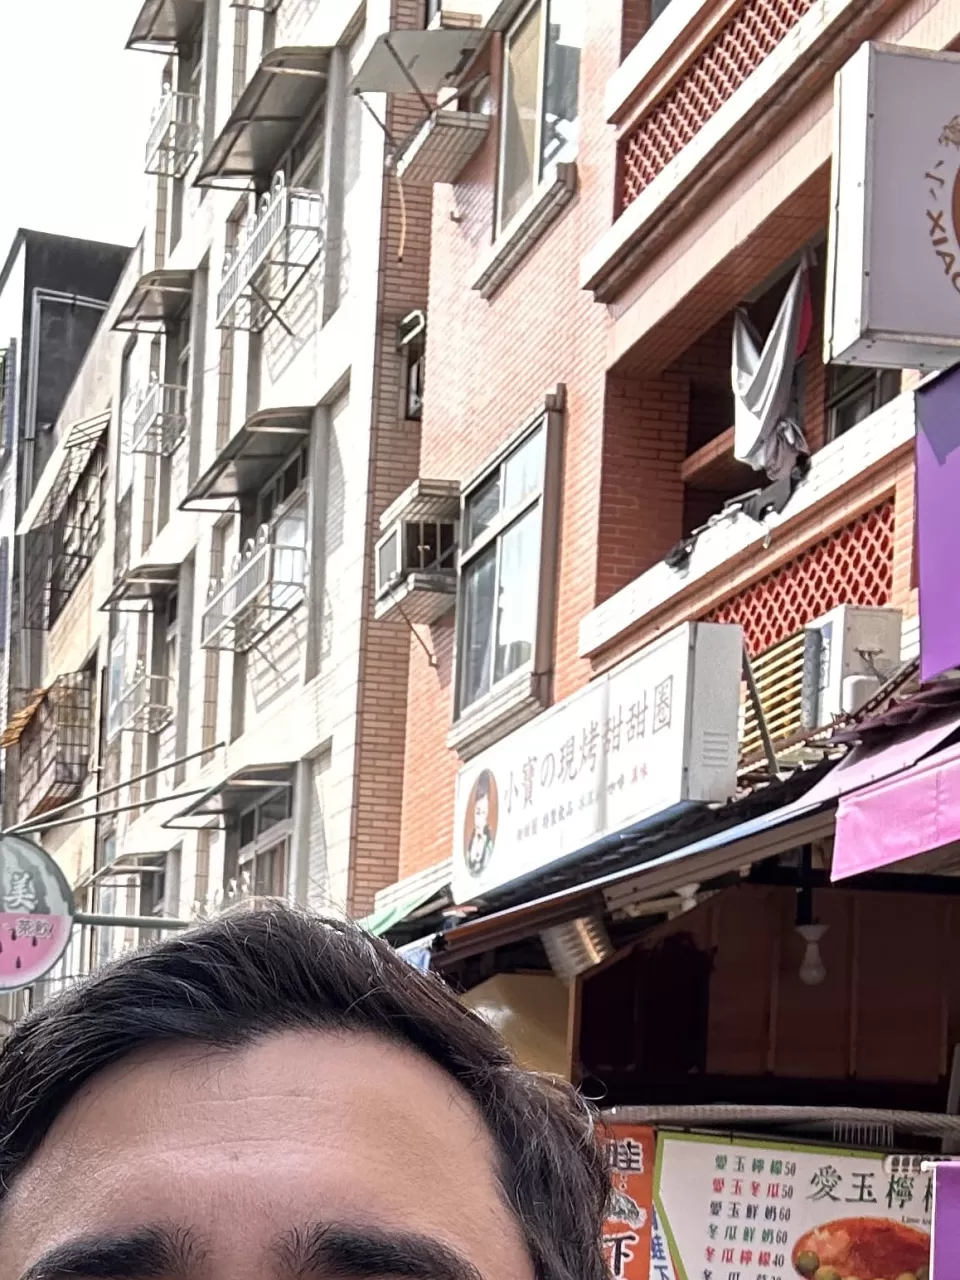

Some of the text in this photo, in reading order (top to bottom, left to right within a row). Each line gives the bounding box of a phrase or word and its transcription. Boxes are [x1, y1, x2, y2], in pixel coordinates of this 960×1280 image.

[504, 674, 674, 815] 小寶の現烤甜甜圈
[783, 1160, 797, 1177] 50
[780, 1183, 794, 1200] 50
[778, 1206, 792, 1222] 60
[775, 1229, 789, 1245] 60
[772, 1253, 785, 1268] 40
